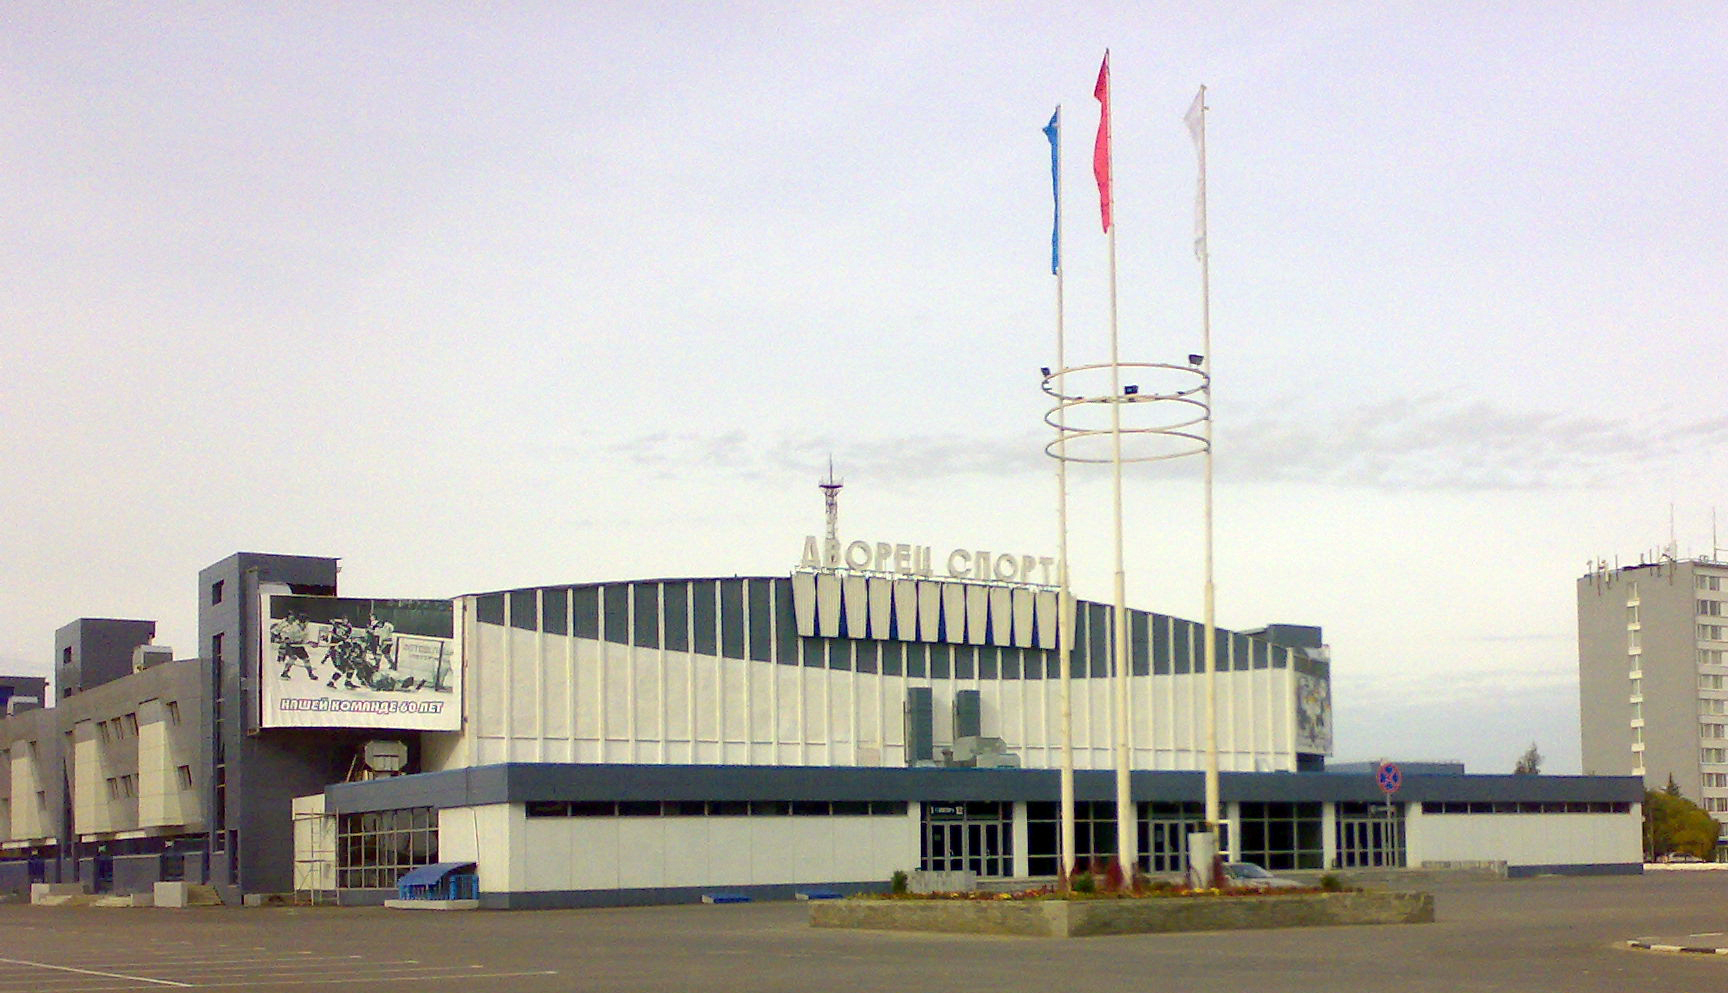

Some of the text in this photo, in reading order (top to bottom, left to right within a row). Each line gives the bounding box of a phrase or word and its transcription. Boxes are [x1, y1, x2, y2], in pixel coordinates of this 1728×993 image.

[801, 535, 1063, 586] ДВОРЕЦ СПОРТ
[280, 697, 444, 714] НАШЕЙ КОМАНДЕ 60 ЛЕТ
